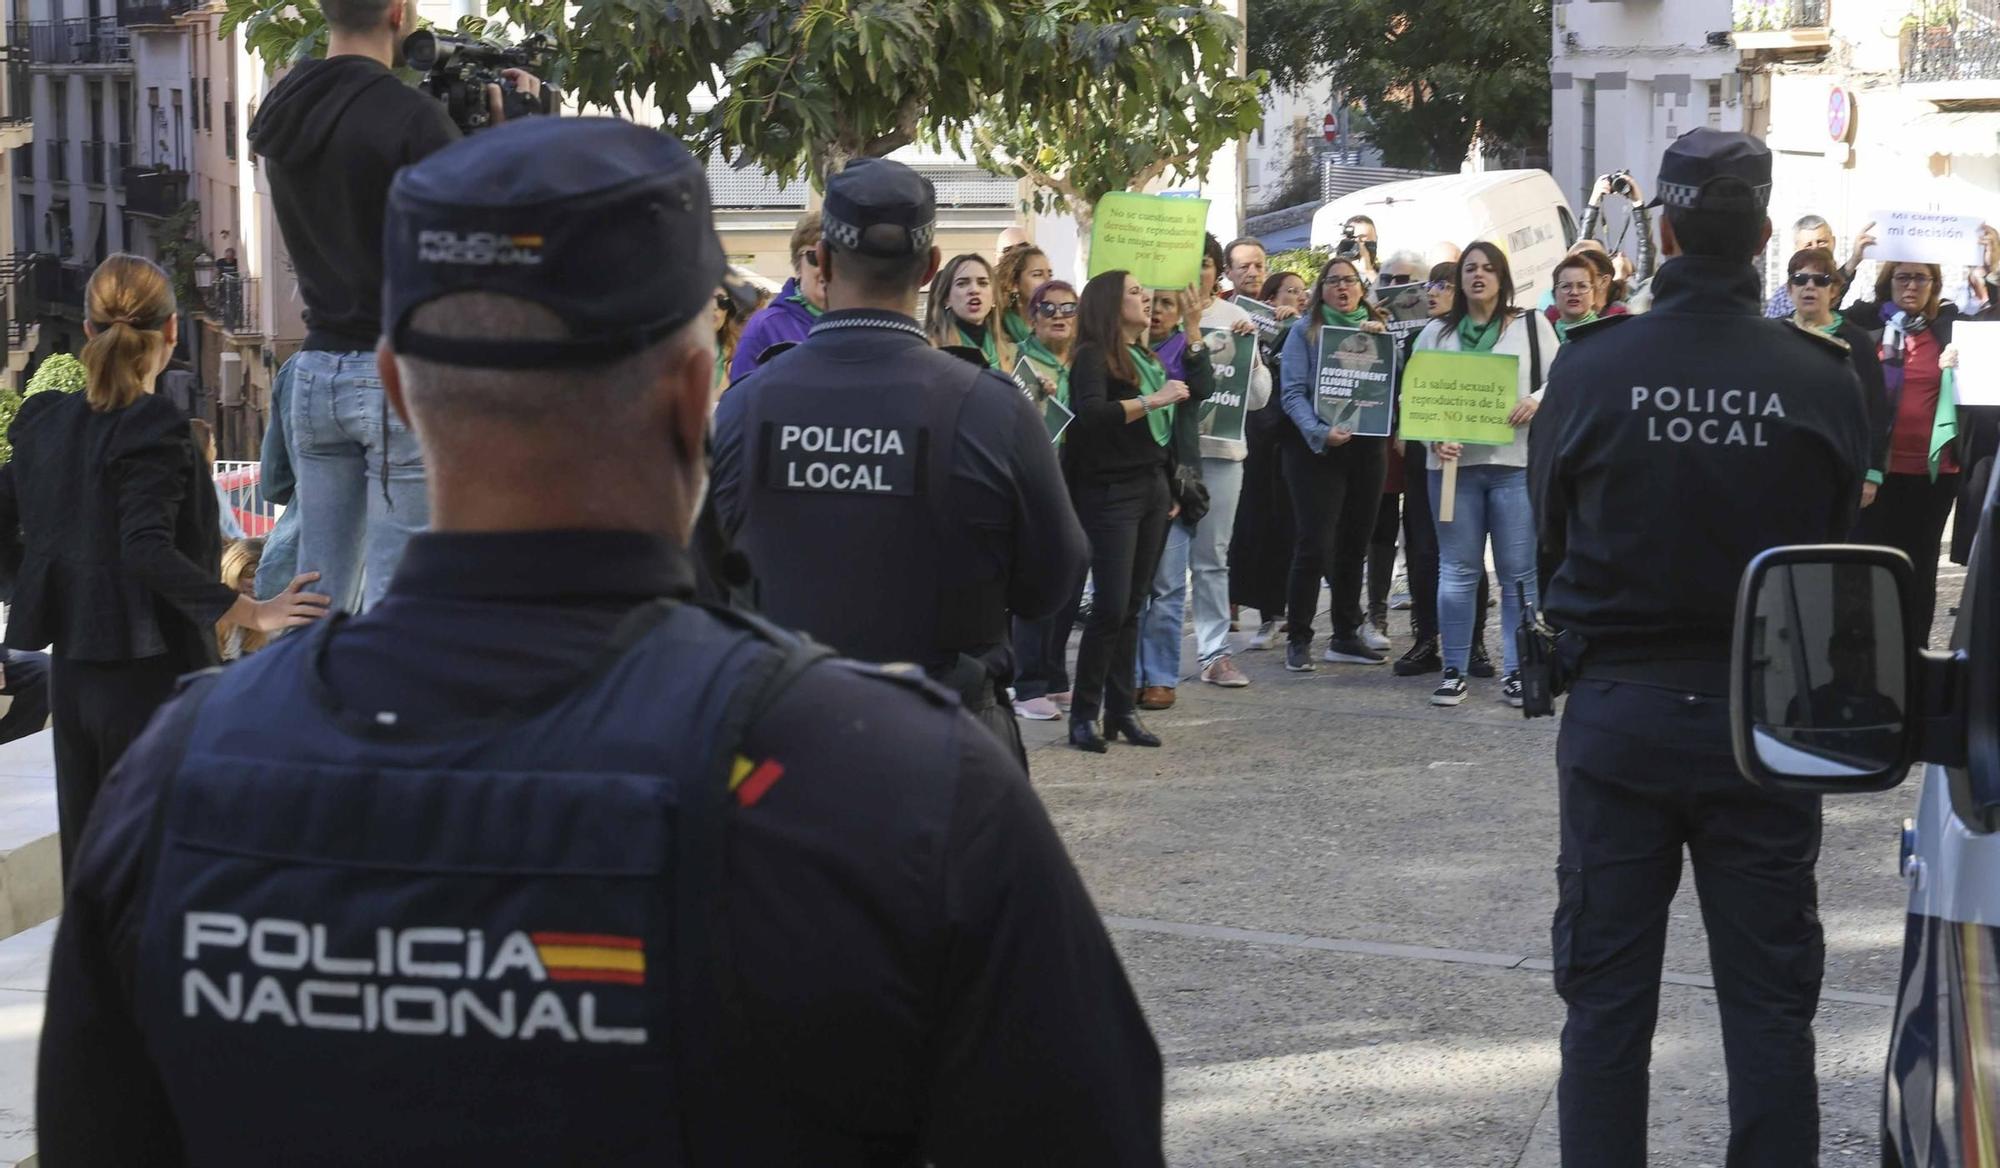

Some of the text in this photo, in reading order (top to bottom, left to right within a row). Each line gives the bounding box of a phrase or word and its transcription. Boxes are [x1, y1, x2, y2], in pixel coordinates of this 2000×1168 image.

[1110, 208, 1124, 217] No
[1127, 211, 1137, 219] se
[1888, 225, 1962, 238] mi decisión
[1104, 234, 1115, 243] de
[1117, 234, 1126, 244] la
[1127, 238, 1154, 247] mujer
[1320, 367, 1389, 381] AVORTAMENT
[1319, 376, 1353, 387] LLIURE
[1413, 377, 1505, 396] La salud sexual y
[1319, 385, 1352, 397] SEGUR
[1411, 396, 1506, 409] reproductiva de la
[1631, 386, 1786, 418] POLICIA
[1443, 411, 1463, 422] NO
[1465, 415, 1477, 423] se
[1648, 417, 1768, 446] LOCAL
[780, 425, 904, 455] POLICIA
[787, 461, 892, 490] LOCAL
[182, 969, 647, 1044] NACIONAL
